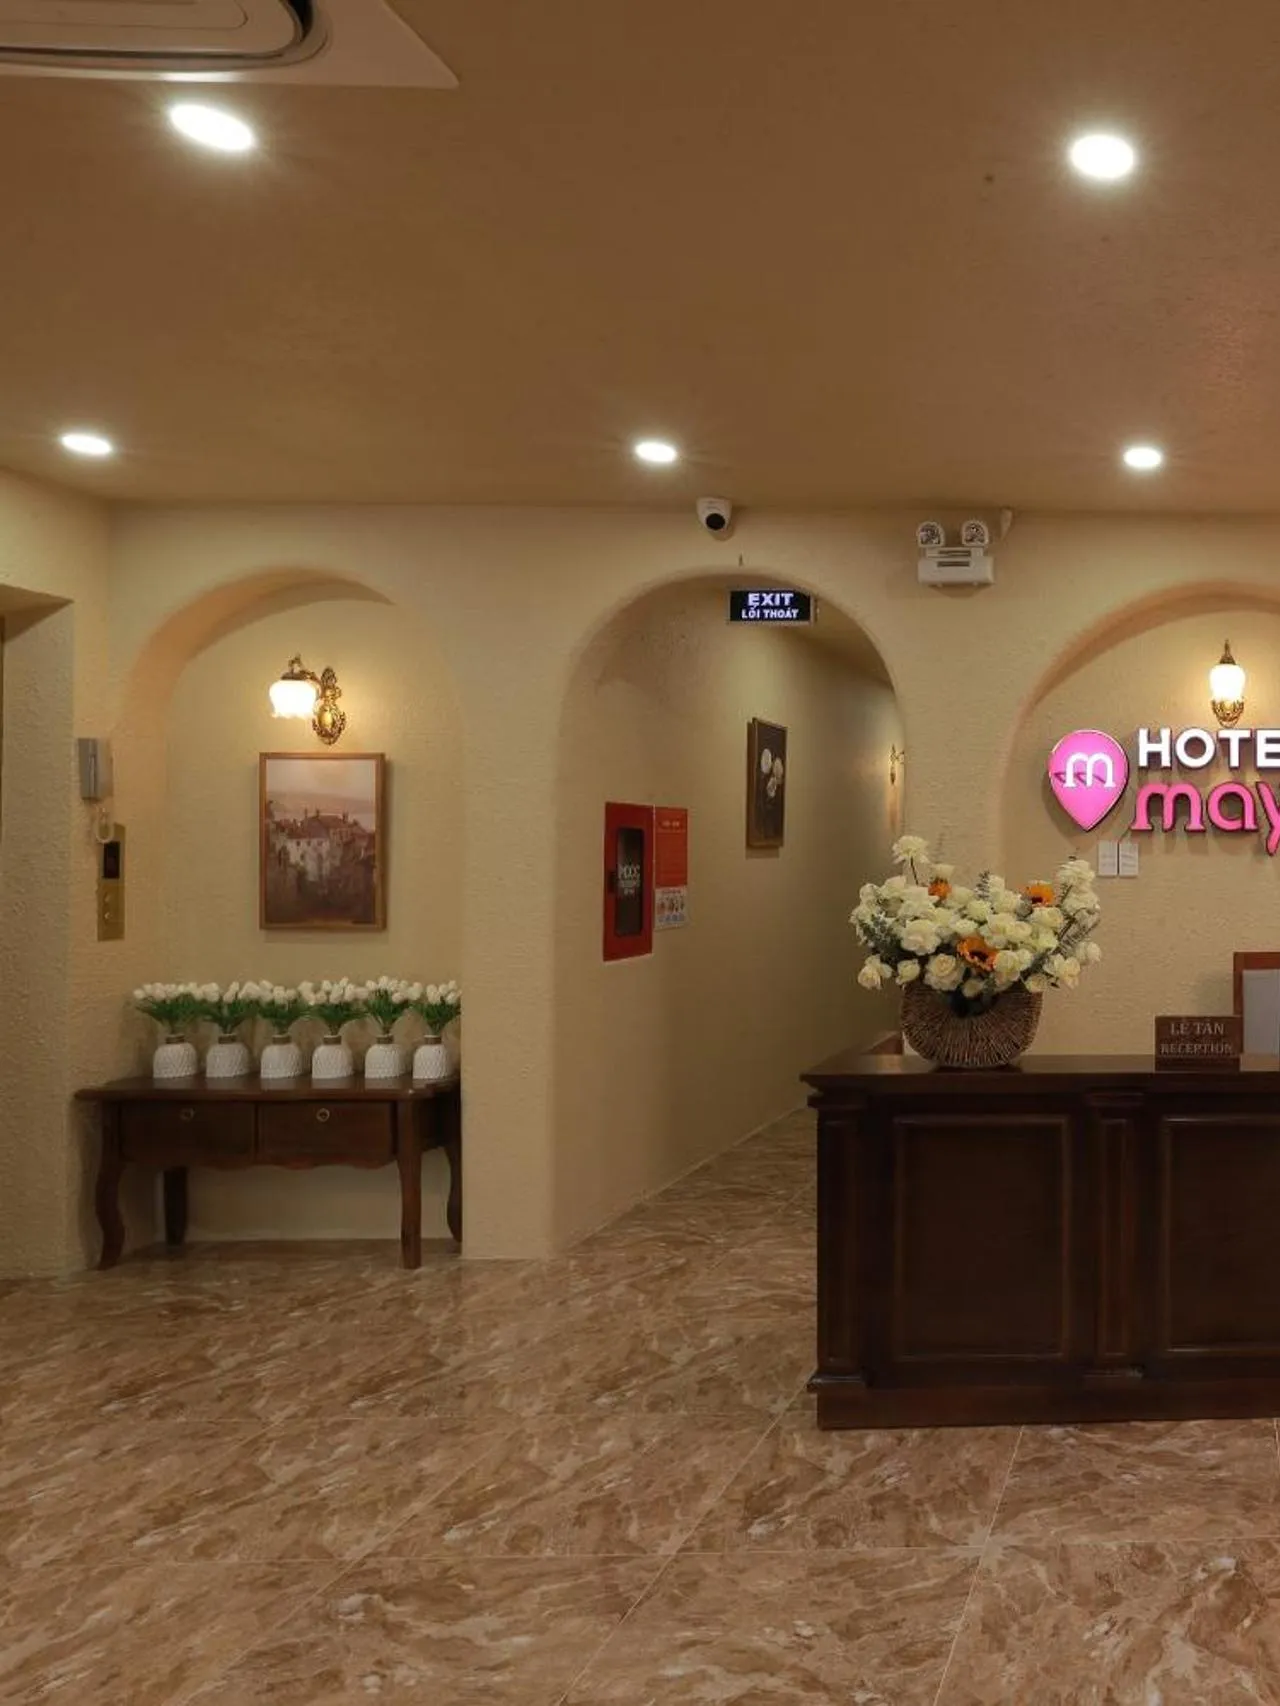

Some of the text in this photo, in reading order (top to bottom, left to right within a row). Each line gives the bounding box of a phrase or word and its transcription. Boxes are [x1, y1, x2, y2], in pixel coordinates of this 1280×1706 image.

[748, 593, 794, 606] EXIT
[741, 605, 799, 619] LỐI THOÁT
